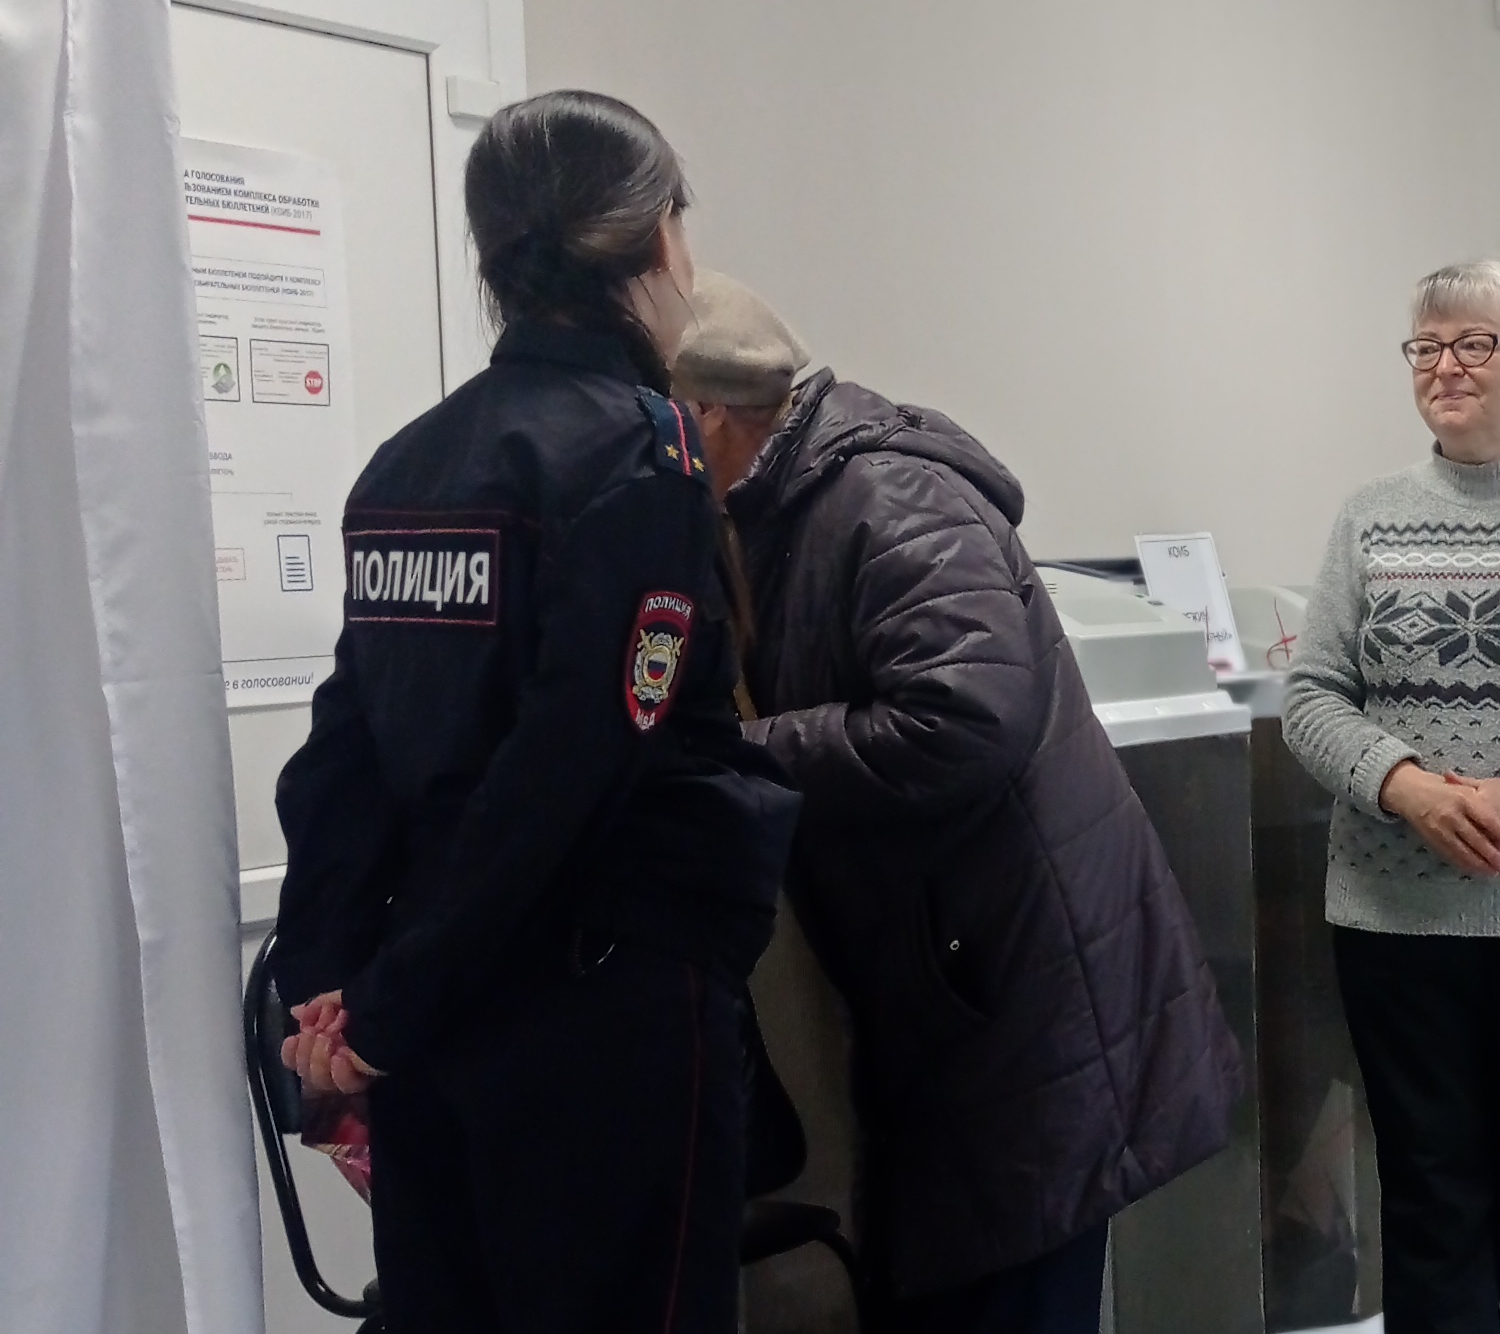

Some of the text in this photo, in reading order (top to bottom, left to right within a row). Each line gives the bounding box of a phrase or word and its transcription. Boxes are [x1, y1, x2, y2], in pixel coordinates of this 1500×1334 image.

[191, 170, 245, 185] ГОЛОСОВАНИЯ
[222, 199, 270, 214] БЮЛЛЕТЕНЕЙ
[233, 189, 277, 202] КОМПЛЕКСА
[278, 195, 320, 208] ОБРАБОТКИ
[353, 550, 490, 612] ПОЛИЦИЯ
[644, 595, 692, 621] ПОЛИЦИЯ
[232, 679, 239, 689] в
[241, 671, 314, 689] голосовании!
